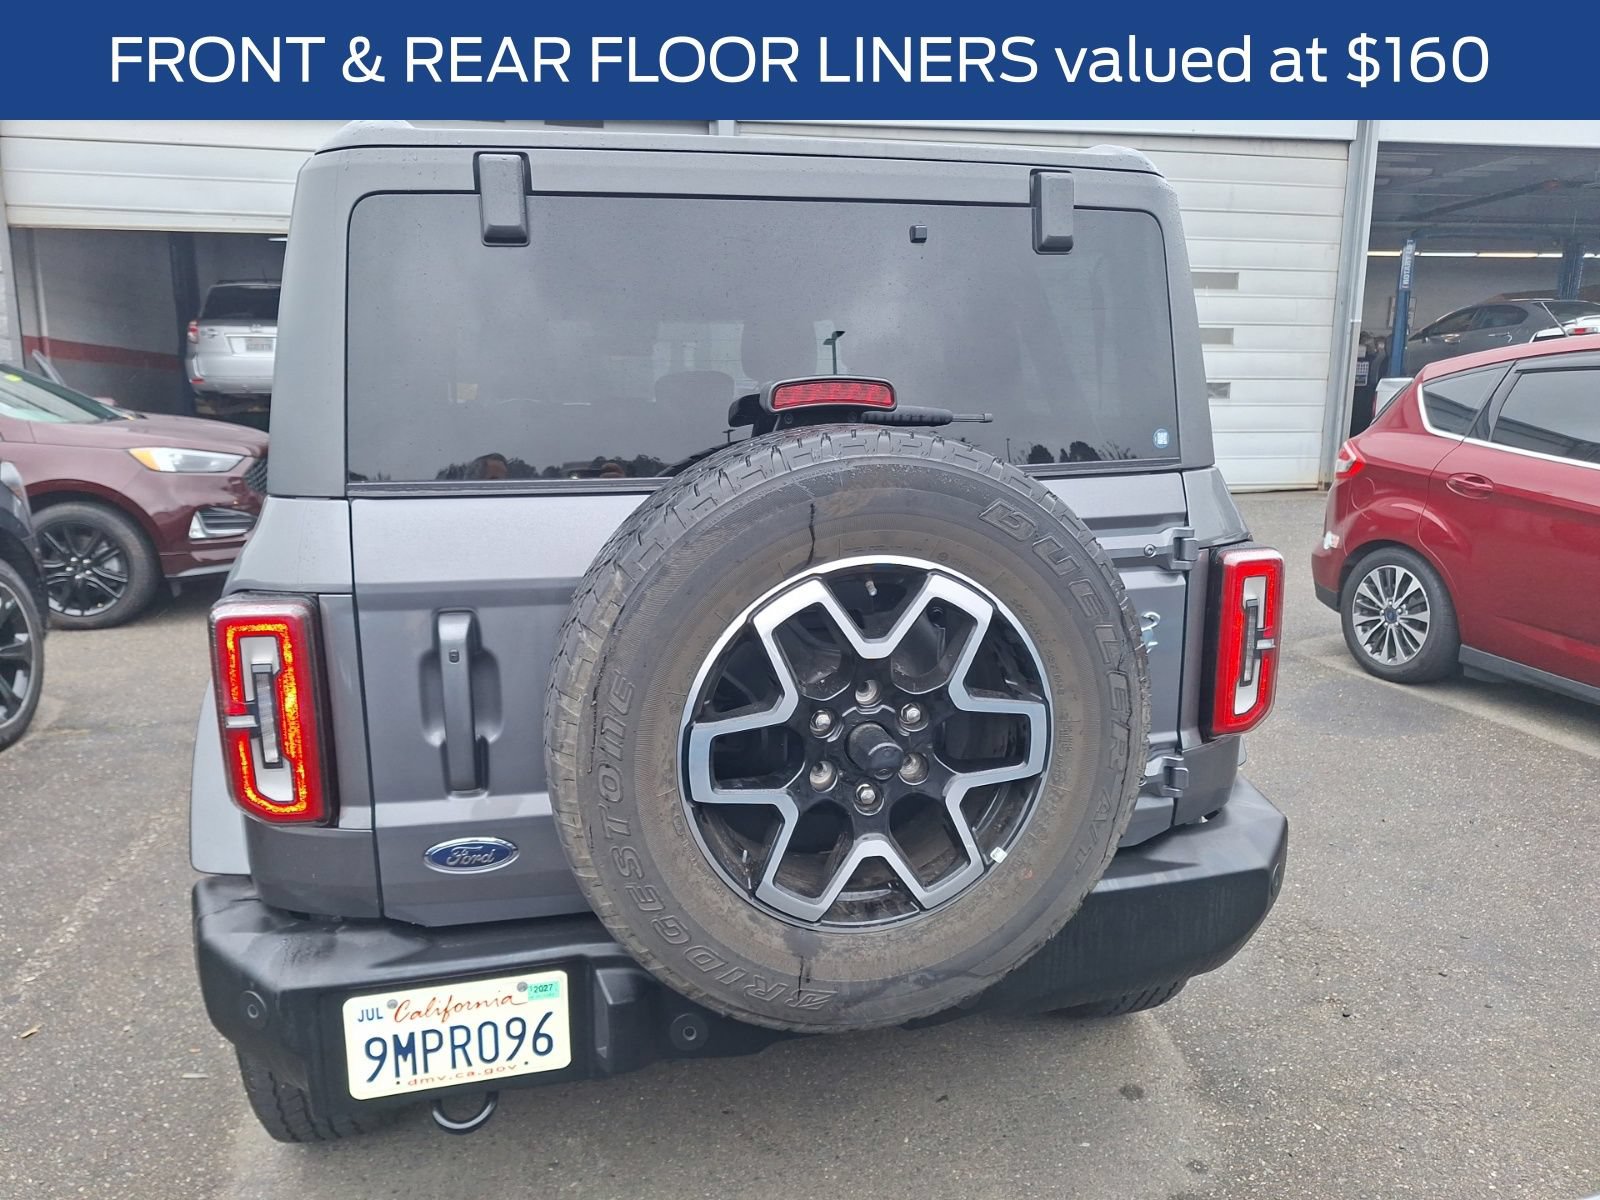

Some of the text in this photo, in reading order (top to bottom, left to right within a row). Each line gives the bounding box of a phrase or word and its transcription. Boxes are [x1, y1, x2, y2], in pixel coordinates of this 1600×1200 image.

[599, 669, 839, 1011] BRIDGESTONE
[446, 845, 497, 866] Ford
[533, 983, 554, 993] 2027
[357, 1008, 384, 1023] JUL
[393, 990, 528, 1024] California
[364, 1011, 555, 1084] 9MPR096
[407, 1063, 518, 1087] dmv.ca.gov
